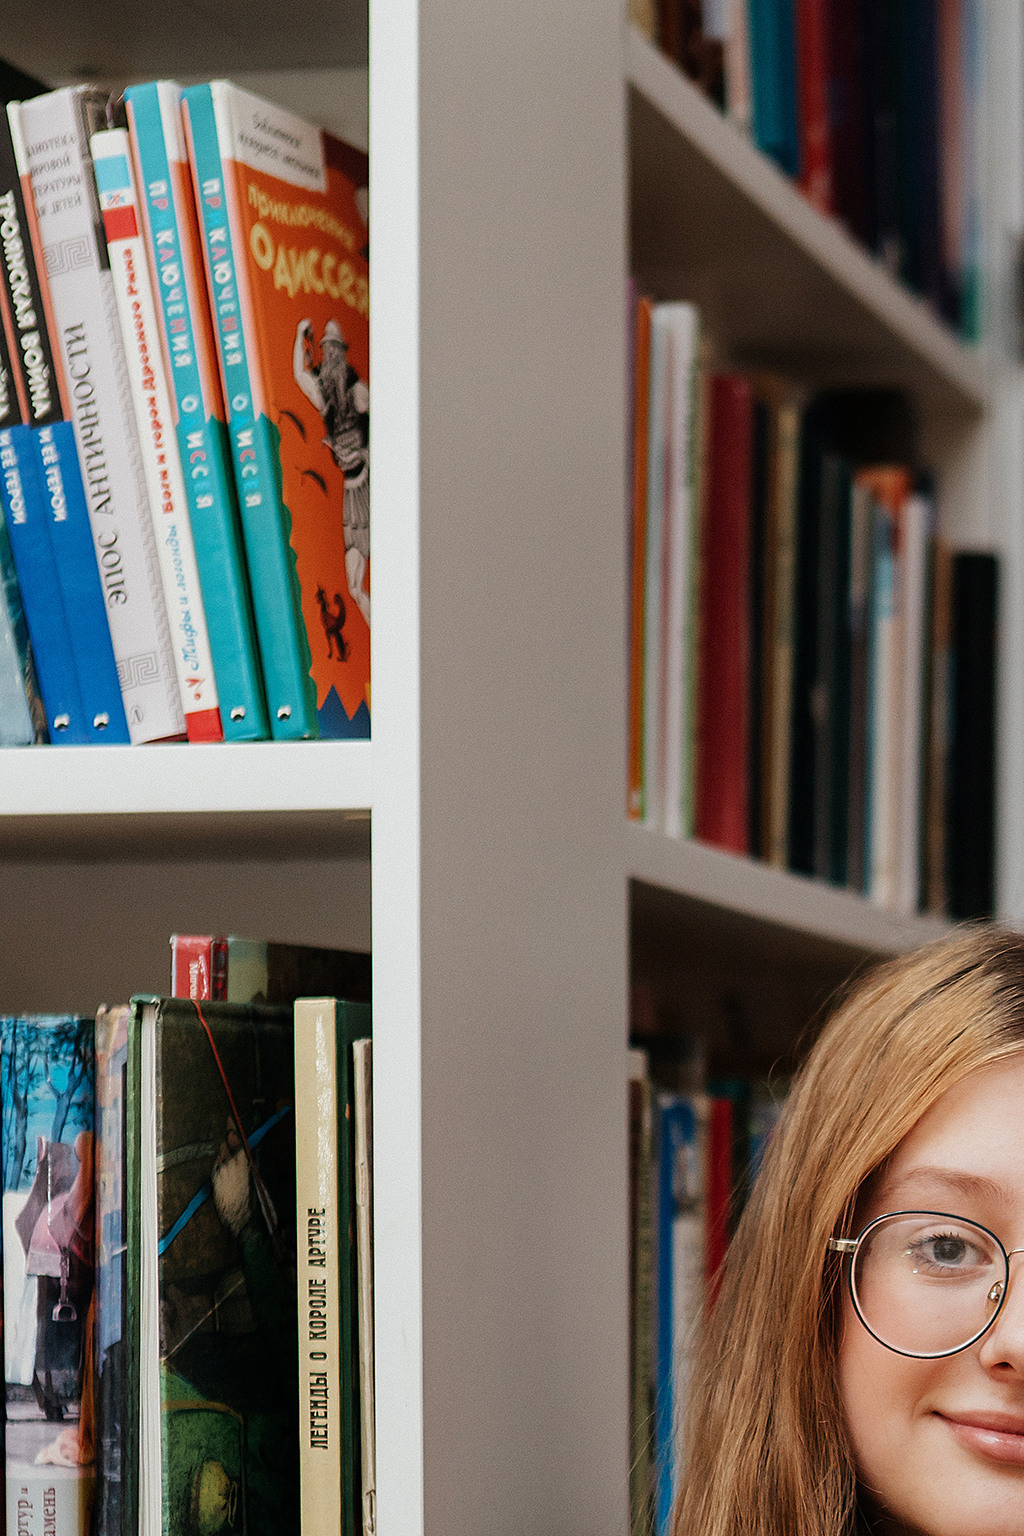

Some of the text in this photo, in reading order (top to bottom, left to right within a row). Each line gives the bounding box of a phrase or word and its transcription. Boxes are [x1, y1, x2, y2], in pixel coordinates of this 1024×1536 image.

[0, 189, 51, 420] ТРОЯНСКАЯ ВОЙНА
[149, 180, 193, 368] ПРИКЛЮЧЕНИЯ
[201, 178, 243, 367] ПРИКЛЮЧЕНИЯ
[4, 468, 28, 525] ГЕРОИ
[45, 465, 68, 523] ГЕРОИ
[64, 322, 128, 609] ЭПОС АНТИЧНОСТИ
[307, 1208, 329, 1451] ЛЕГЕНДЫ О КОРОЛЕ АРТУРЕ
[21, 1486, 29, 1495] и
